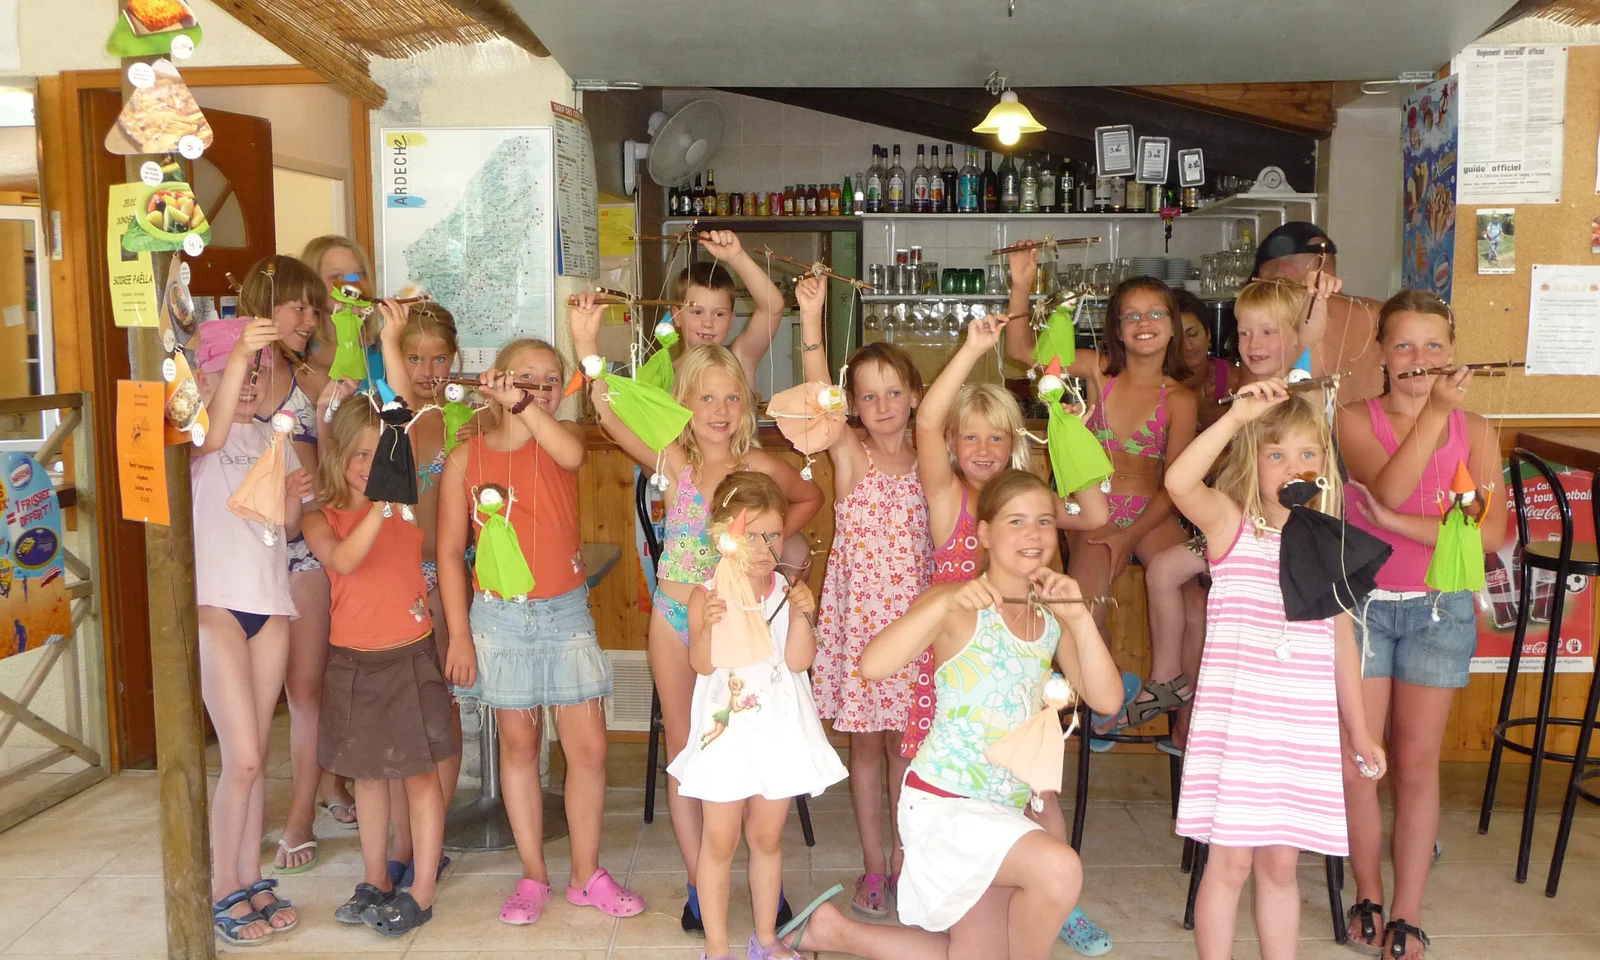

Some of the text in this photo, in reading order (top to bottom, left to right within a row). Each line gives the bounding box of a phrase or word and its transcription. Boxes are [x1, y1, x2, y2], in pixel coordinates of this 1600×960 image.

[1463, 164, 1521, 174] guide officiel
[21, 488, 51, 511] FRISBEE
[1534, 493, 1553, 503] tous
